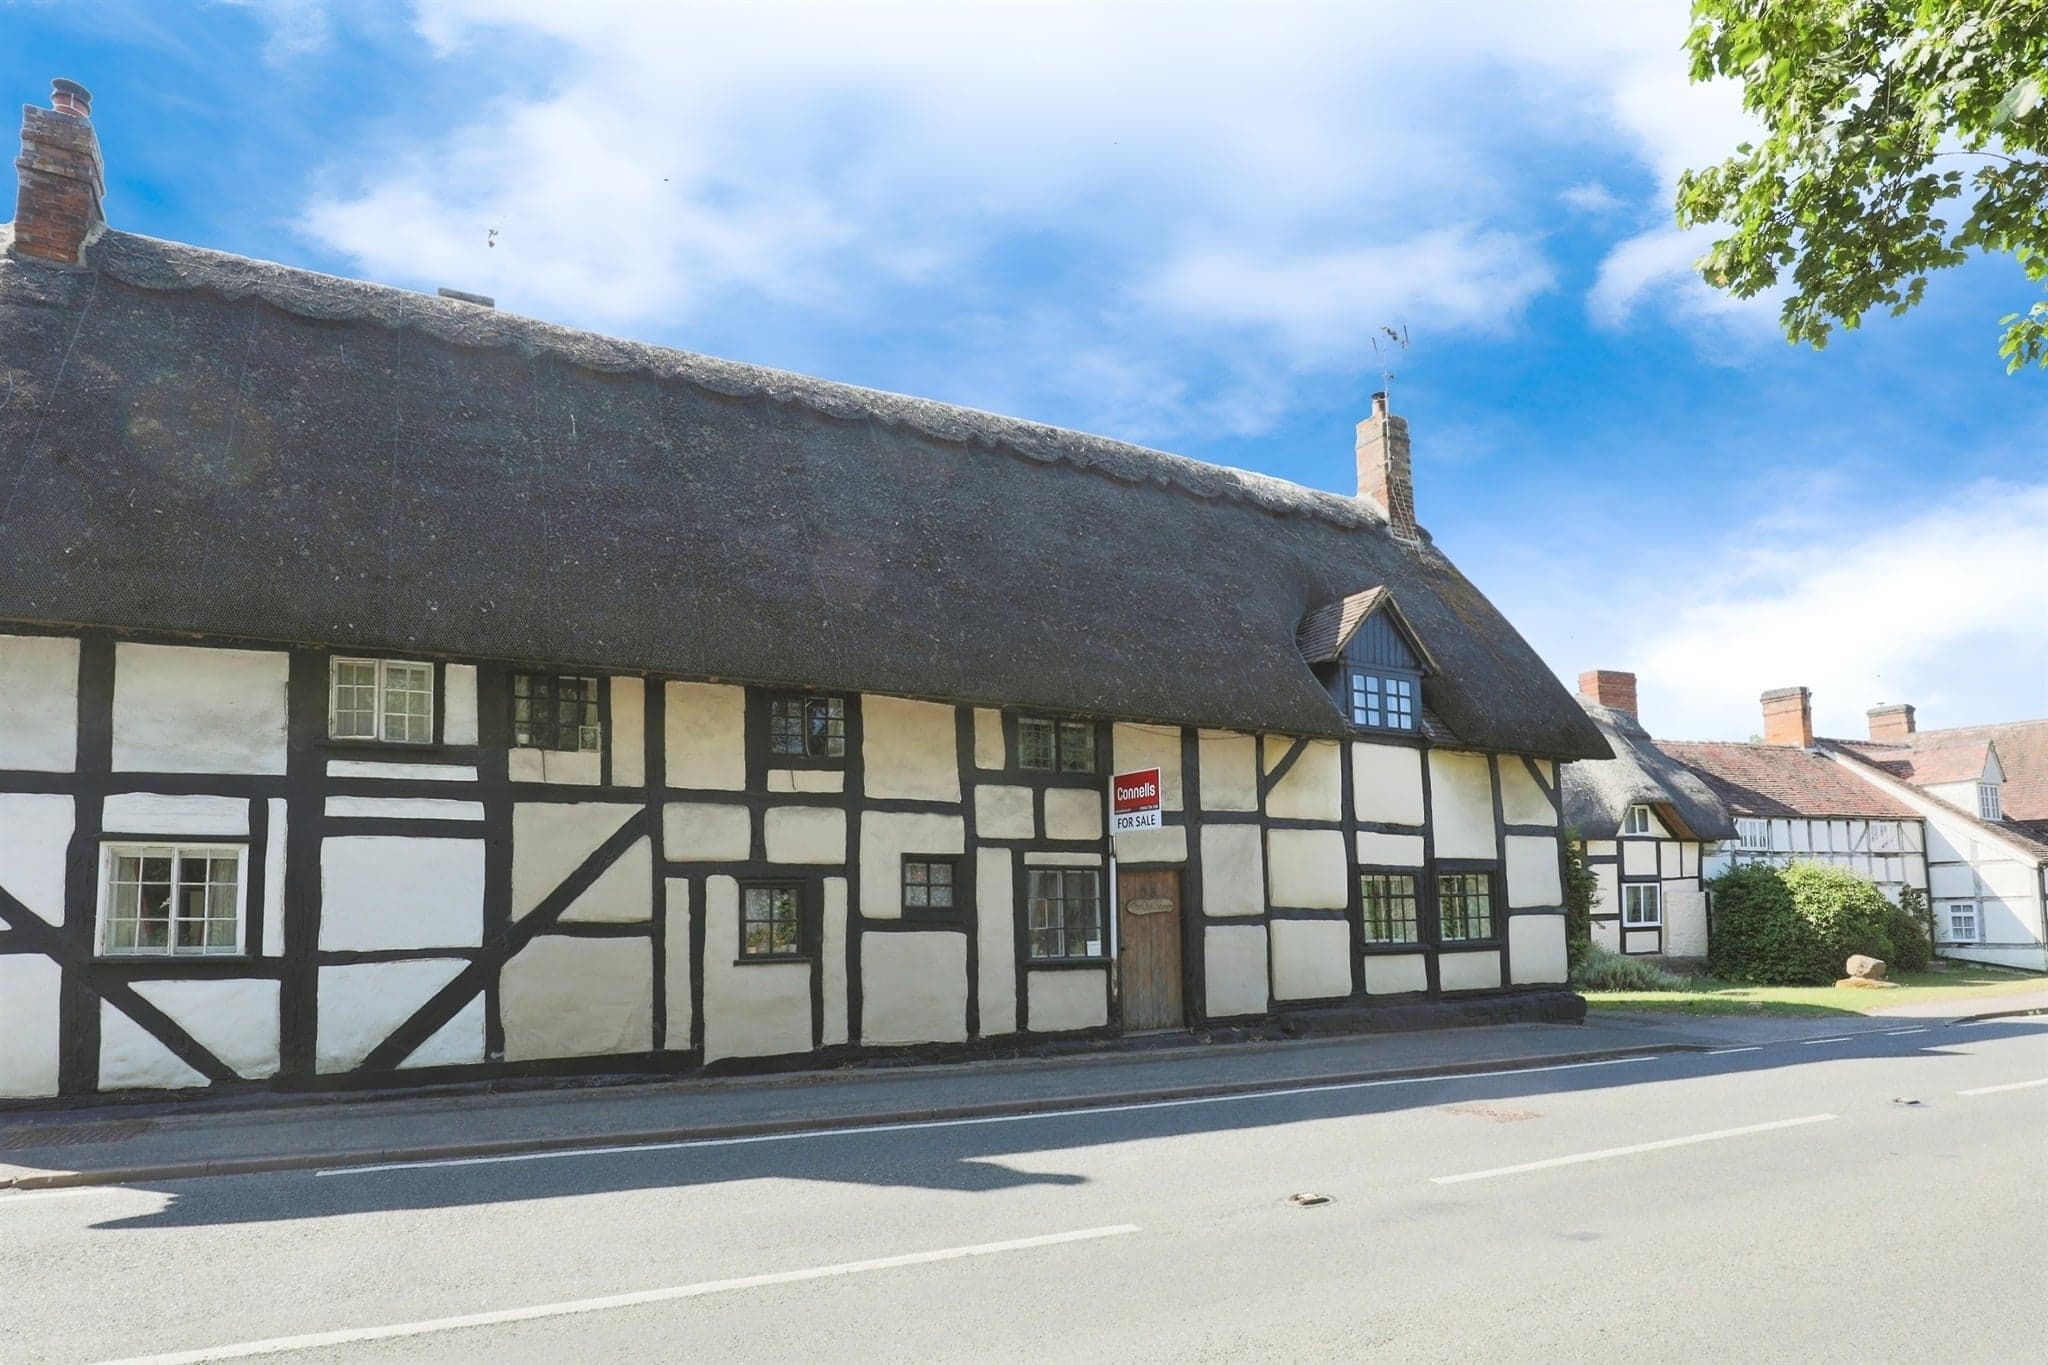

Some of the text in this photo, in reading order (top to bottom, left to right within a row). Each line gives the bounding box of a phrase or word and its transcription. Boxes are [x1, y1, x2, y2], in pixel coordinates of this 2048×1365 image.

[1117, 782, 1156, 801] Connells
[1117, 814, 1156, 829] FOR SALE
